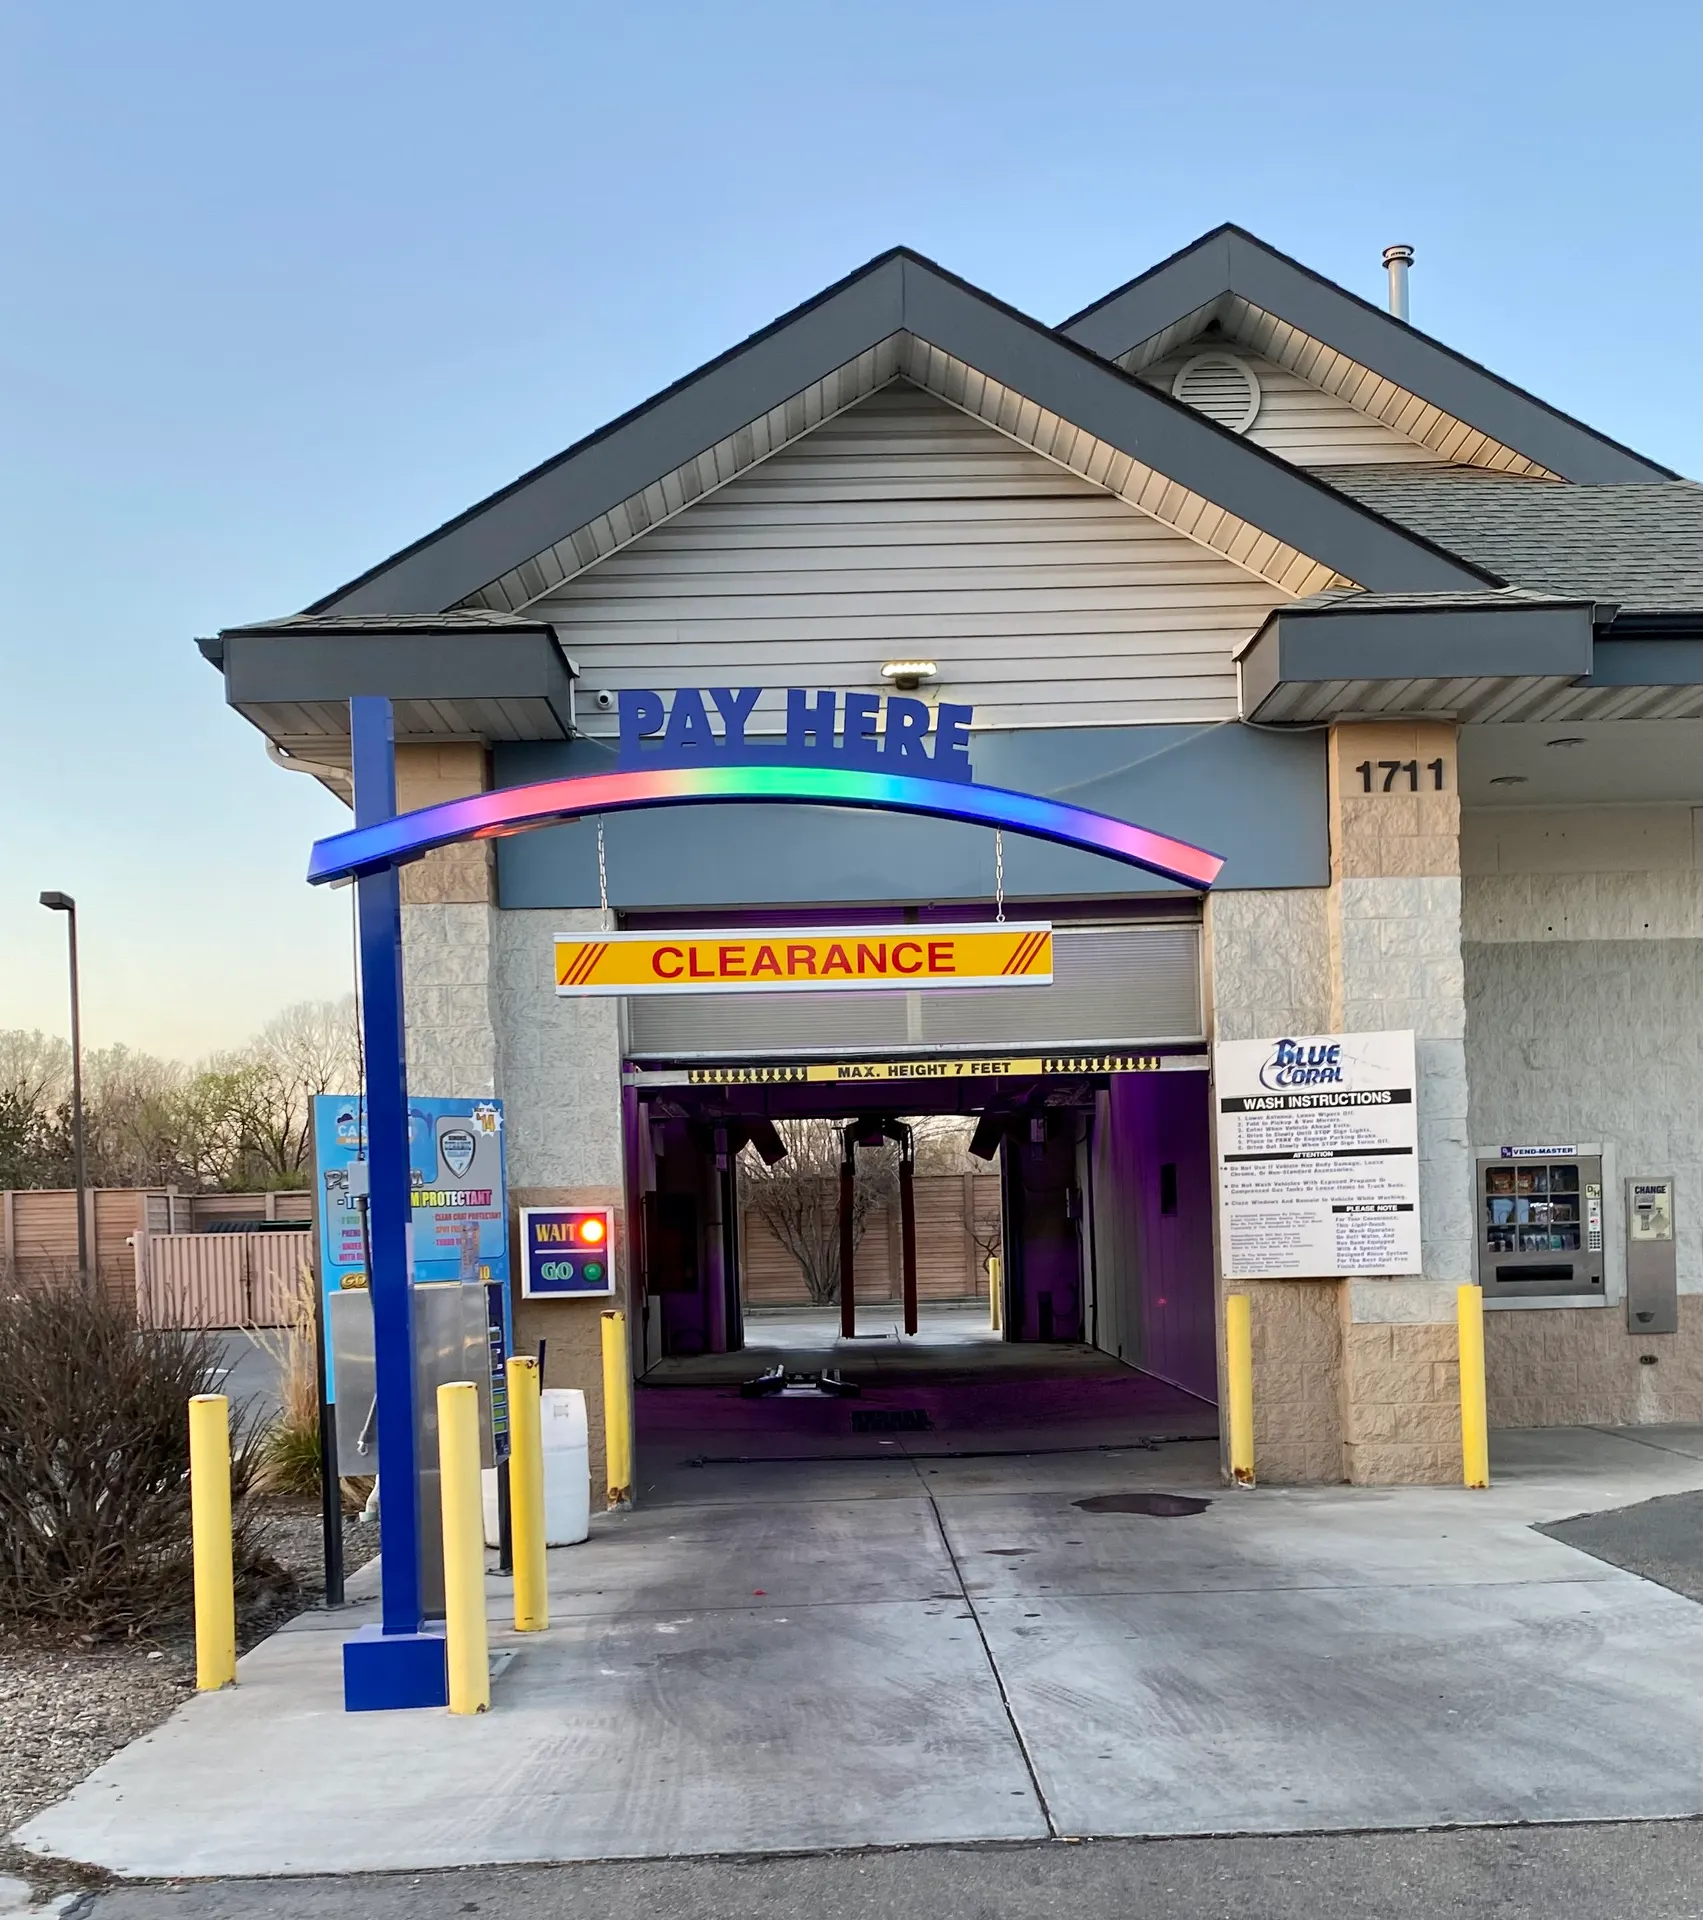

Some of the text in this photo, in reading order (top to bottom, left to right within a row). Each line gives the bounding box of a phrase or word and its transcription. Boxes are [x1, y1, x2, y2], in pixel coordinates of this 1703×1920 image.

[618, 688, 973, 764] PAY HERE
[1355, 758, 1443, 793] 1711
[651, 941, 956, 979] CLEARANCE
[1271, 1038, 1341, 1068] BLUE
[837, 1062, 1011, 1078] MAX. HEIGHT 7 FEET
[1275, 1064, 1343, 1088] CORAL
[1243, 1091, 1392, 1110] WASH INSTRUCTIONS
[1293, 1150, 1334, 1159] ATTENTION
[1513, 1147, 1573, 1155] VEND-MASTER
[421, 1189, 492, 1208] PROTECTANT
[1634, 1185, 1667, 1194] CHANGE
[535, 1223, 576, 1242] WAIT
[541, 1261, 574, 1281] GO
